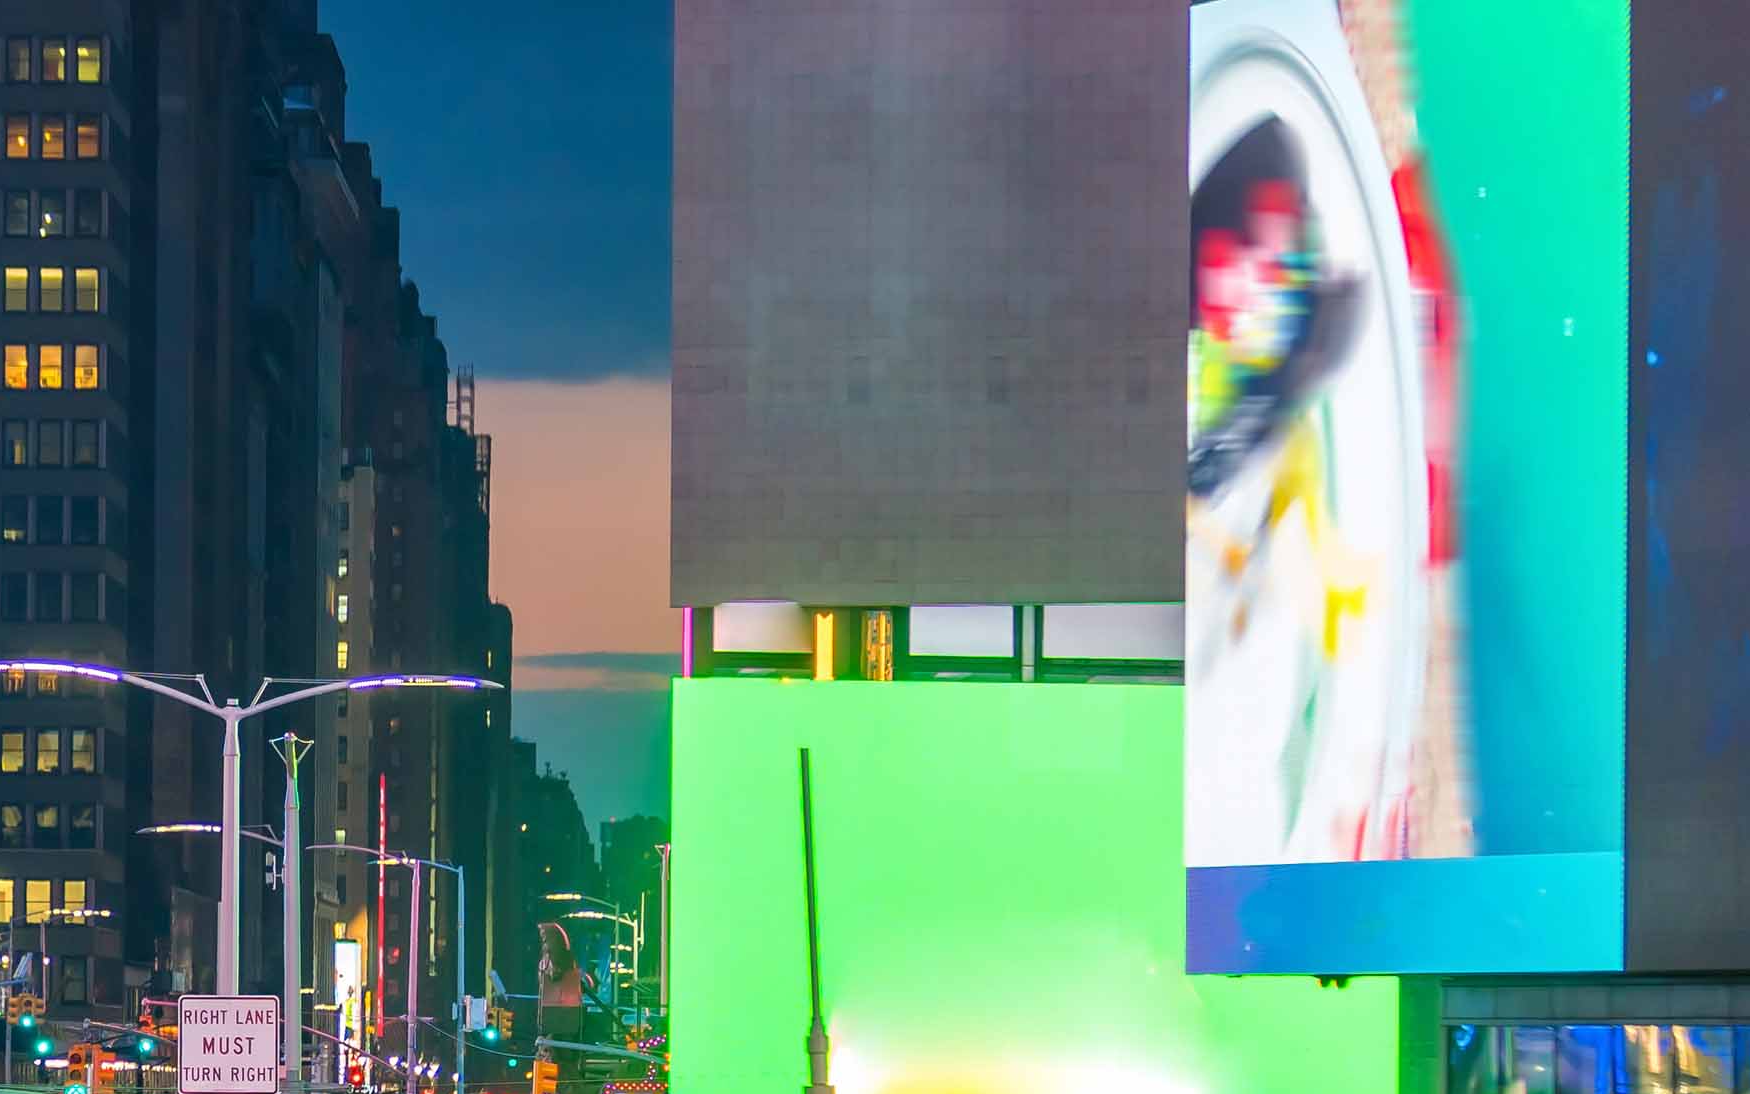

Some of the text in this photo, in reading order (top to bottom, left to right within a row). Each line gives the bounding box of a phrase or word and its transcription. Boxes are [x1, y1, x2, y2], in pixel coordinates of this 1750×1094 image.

[184, 1010, 274, 1025] RIGHT LANE
[203, 1036, 255, 1055] MUST
[183, 1067, 274, 1081] TURN RIGHT
